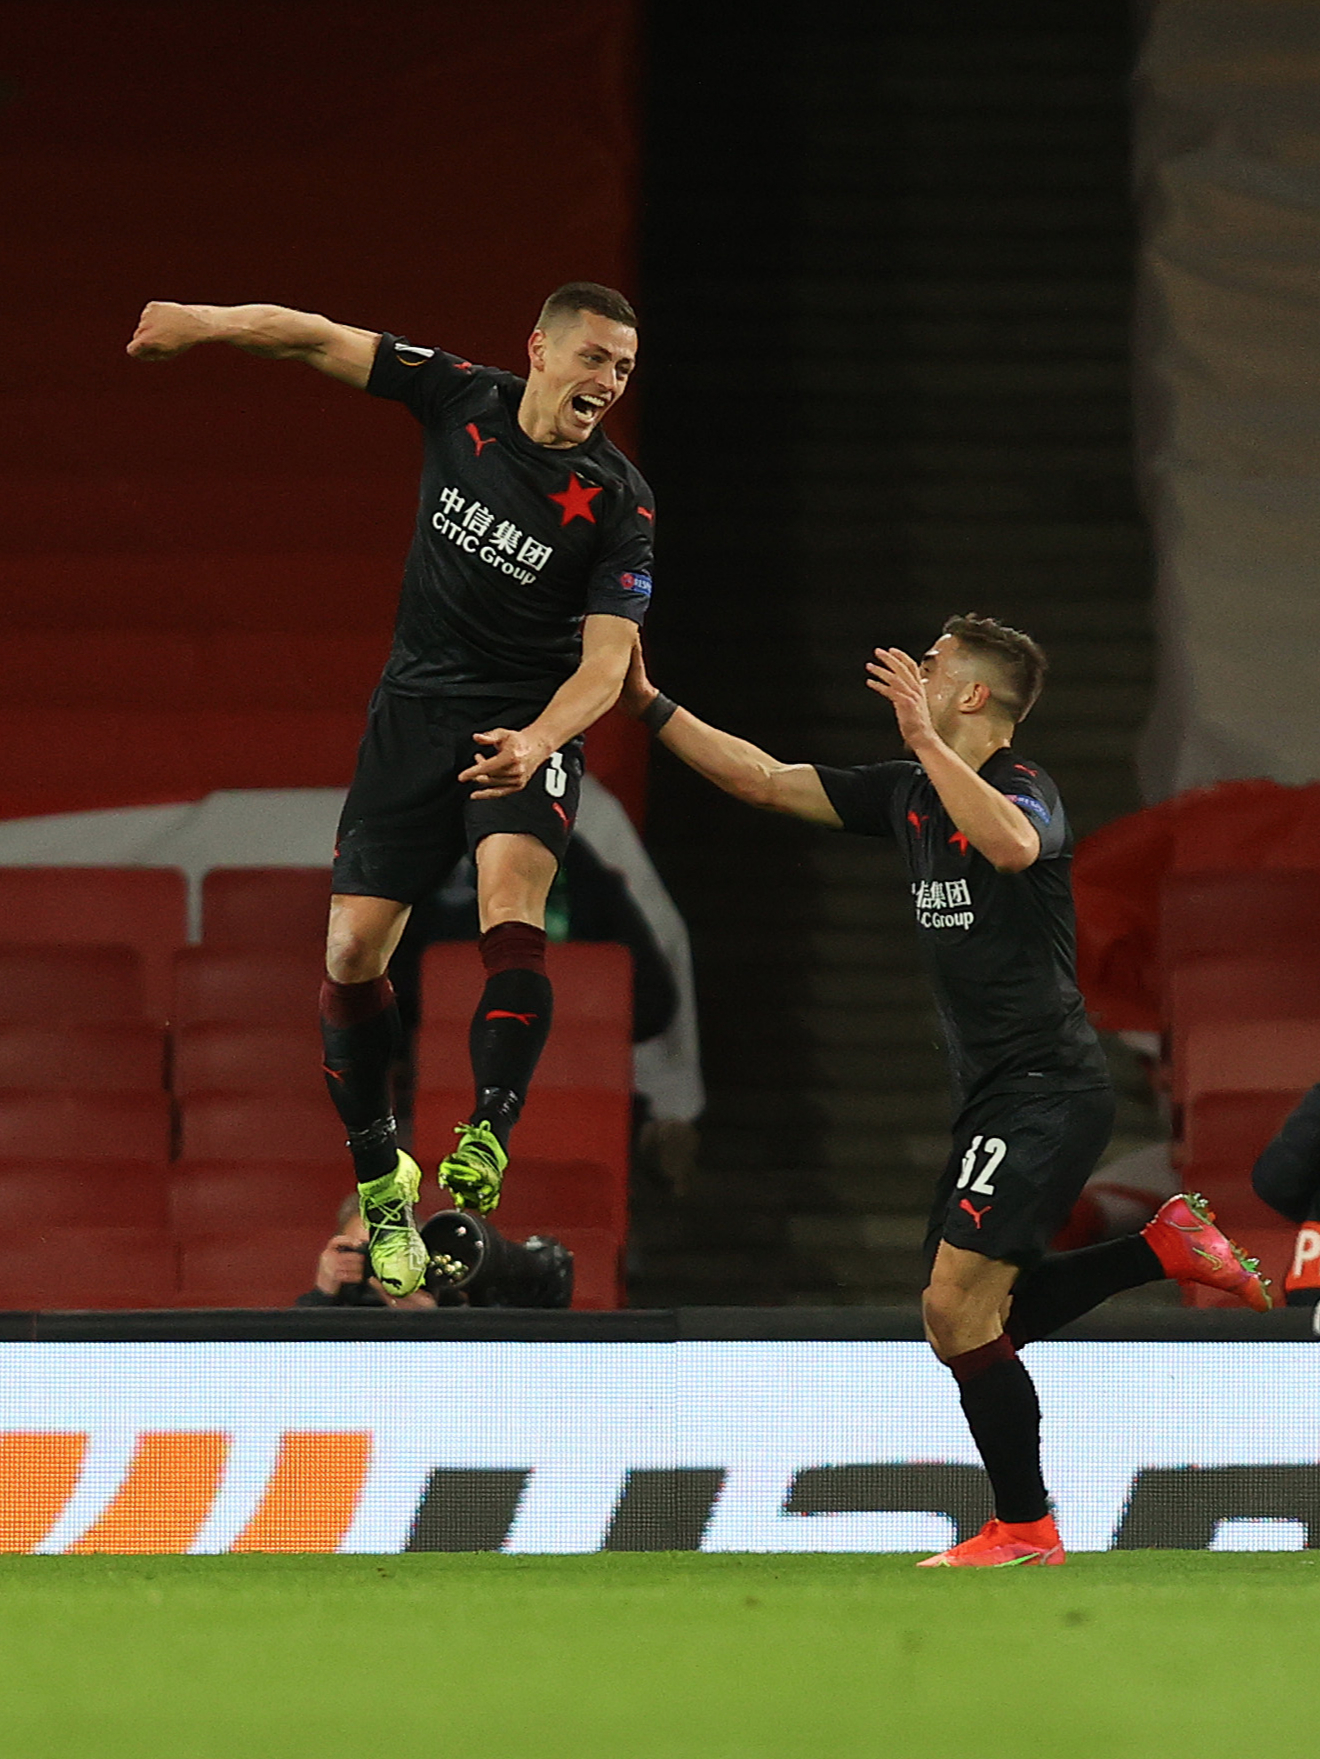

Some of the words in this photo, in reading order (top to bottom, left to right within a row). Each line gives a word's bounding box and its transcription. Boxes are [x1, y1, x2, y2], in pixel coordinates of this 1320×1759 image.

[432, 511, 480, 553] CITIC
[479, 546, 536, 585] Group
[440, 487, 553, 571] 中信集团
[932, 911, 974, 930] Group
